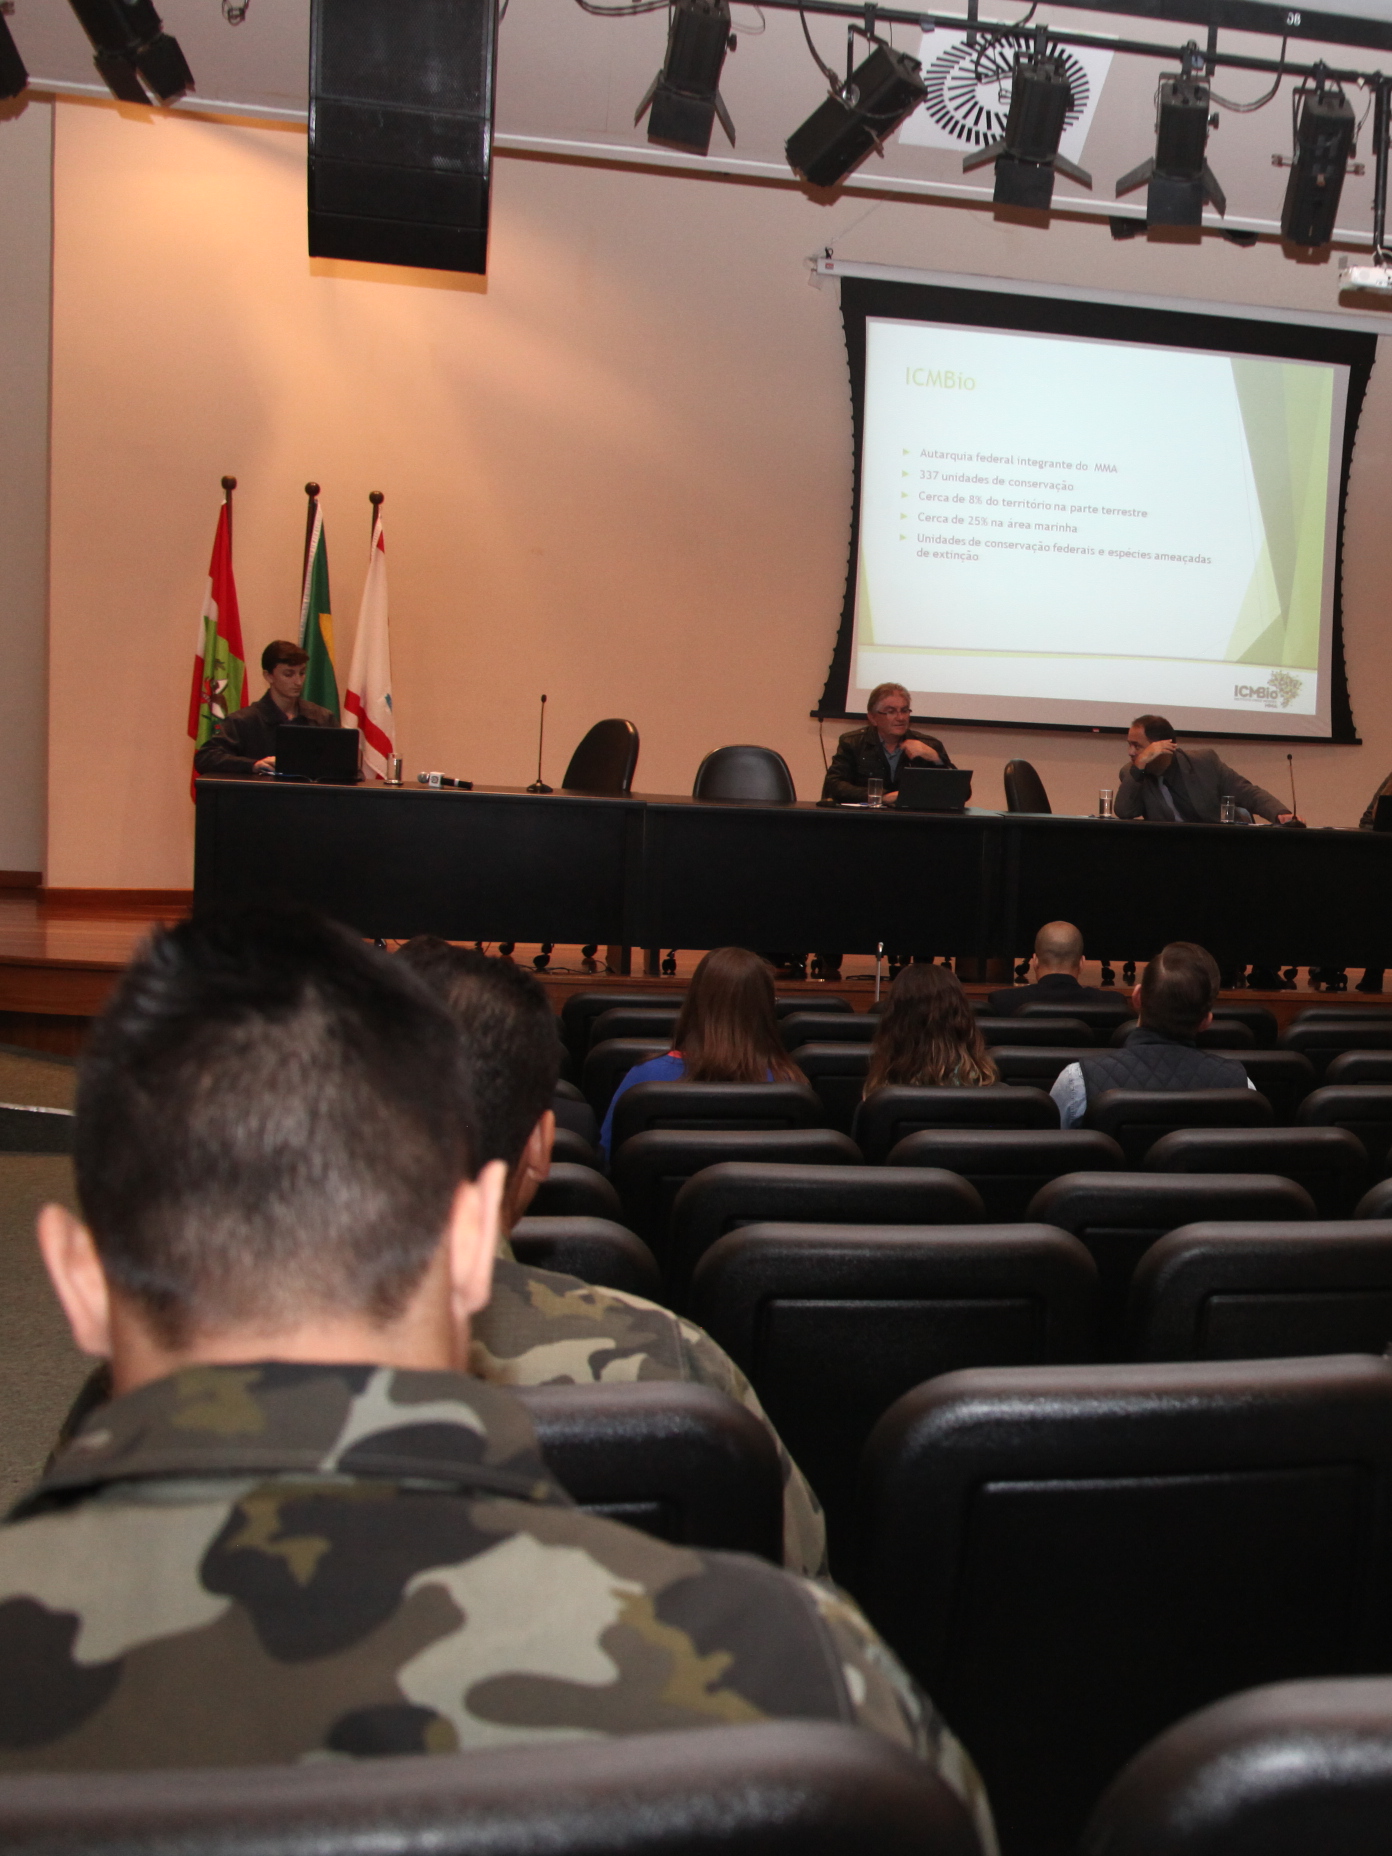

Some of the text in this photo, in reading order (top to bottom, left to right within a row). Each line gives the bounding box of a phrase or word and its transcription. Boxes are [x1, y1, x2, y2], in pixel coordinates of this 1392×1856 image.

[906, 367, 976, 391] ICMBio
[920, 448, 1118, 473] Autarquia federal integrante do MMA
[920, 470, 1074, 493] 337 unidades de conservação
[918, 491, 1148, 518] Cerca de 8% do território na parte terrestre
[917, 512, 1078, 534] Cerca de 25% na área marinha
[916, 547, 979, 563] de extinção
[917, 533, 1212, 565] Unidades de conservação federais e espécies ameaçadas
[1234, 685, 1278, 699] ICMBio
